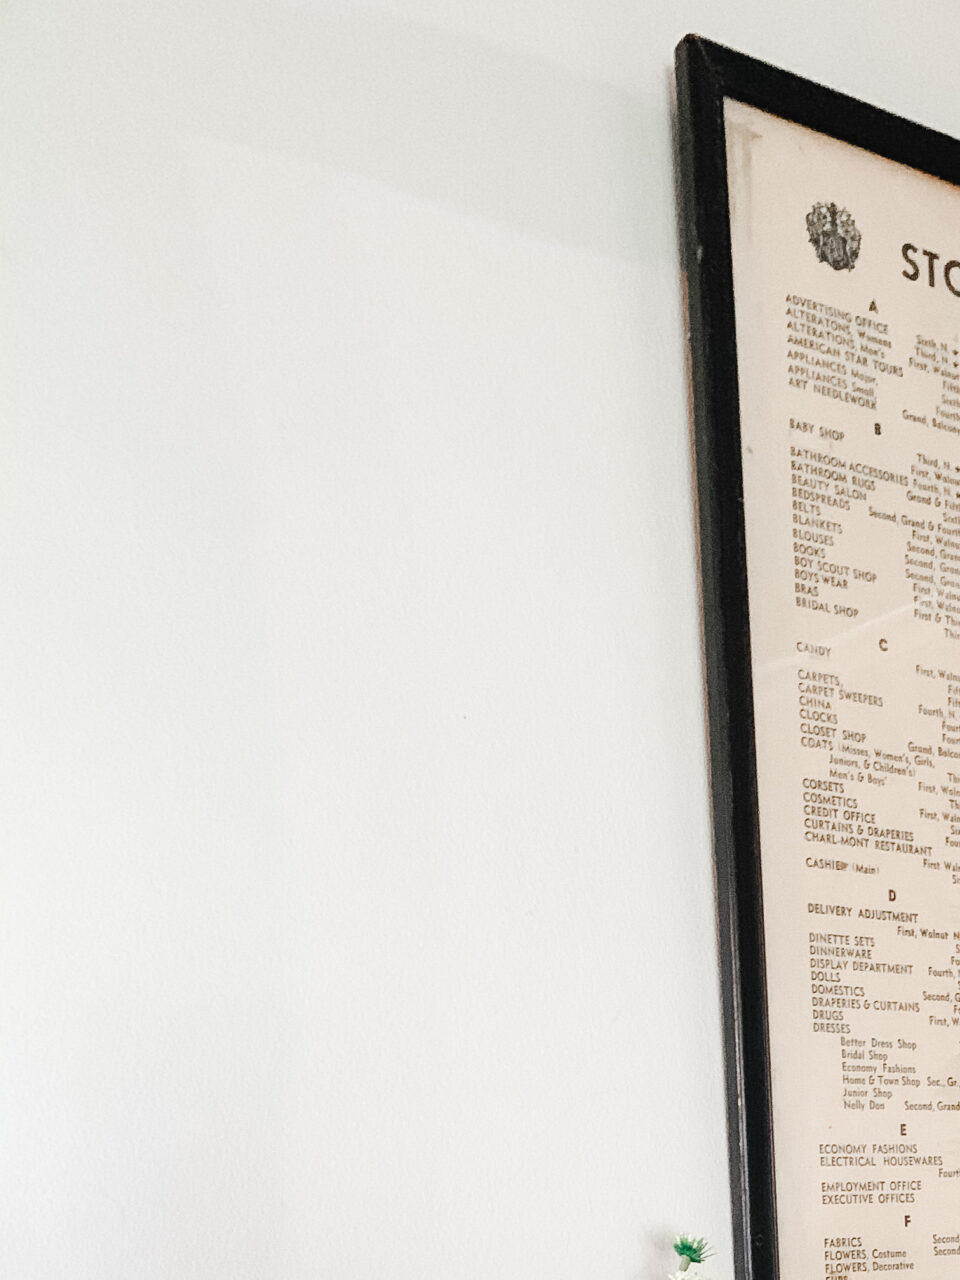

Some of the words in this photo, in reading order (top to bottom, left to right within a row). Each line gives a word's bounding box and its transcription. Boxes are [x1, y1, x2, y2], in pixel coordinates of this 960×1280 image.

[787, 334, 840, 356] AMERICAN
[844, 350, 867, 366] STAR
[872, 359, 903, 377] TOURS
[789, 417, 814, 433] BABY
[819, 426, 844, 440] SHOP
[878, 638, 888, 651] C
[797, 682, 834, 697] CARPET
[838, 688, 882, 707] SWEEPERS
[798, 695, 831, 709] CHINA
[799, 708, 837, 724] CLOCKS
[802, 777, 844, 793] CORSETS
[802, 791, 857, 809] COSMETICS
[803, 804, 838, 818] CREDIT
[842, 809, 875, 824] OFFICE
[803, 817, 853, 834] CURTAINS
[856, 824, 864, 835] &
[867, 825, 914, 842] DRAPERIES
[888, 888, 896, 901] D
[807, 902, 852, 916] DELIVERY
[857, 908, 918, 923] ADJUSTMENT
[808, 932, 850, 945] DINETTE
[854, 935, 874, 947] SETS
[809, 944, 871, 959] DINNERWARE
[810, 970, 840, 982] DOLLS
[811, 983, 864, 996] DOMESTICS
[811, 996, 860, 1009] DRAPERIES
[863, 999, 870, 1009] &
[873, 1000, 920, 1012] CURTAINS
[812, 1008, 843, 1021] DRUGS
[812, 1021, 850, 1034] DRESSES
[840, 1036, 865, 1047] Better
[871, 1037, 892, 1048] Dress
[897, 1038, 916, 1050] Shop
[899, 1123, 907, 1136] E
[818, 1143, 866, 1154] ECONOMY
[872, 1143, 917, 1153] FASHIONS
[820, 1155, 876, 1166] ELECTRICAL
[883, 1155, 942, 1166] HOUSEWARES
[820, 1180, 885, 1192] EMPLOYMENT
[889, 1180, 921, 1190] OFFICE
[821, 1193, 873, 1204] EXECUTIVE
[877, 1192, 915, 1203] OFFICES
[904, 1214, 911, 1227] F
[823, 1236, 862, 1248] FABRICS
